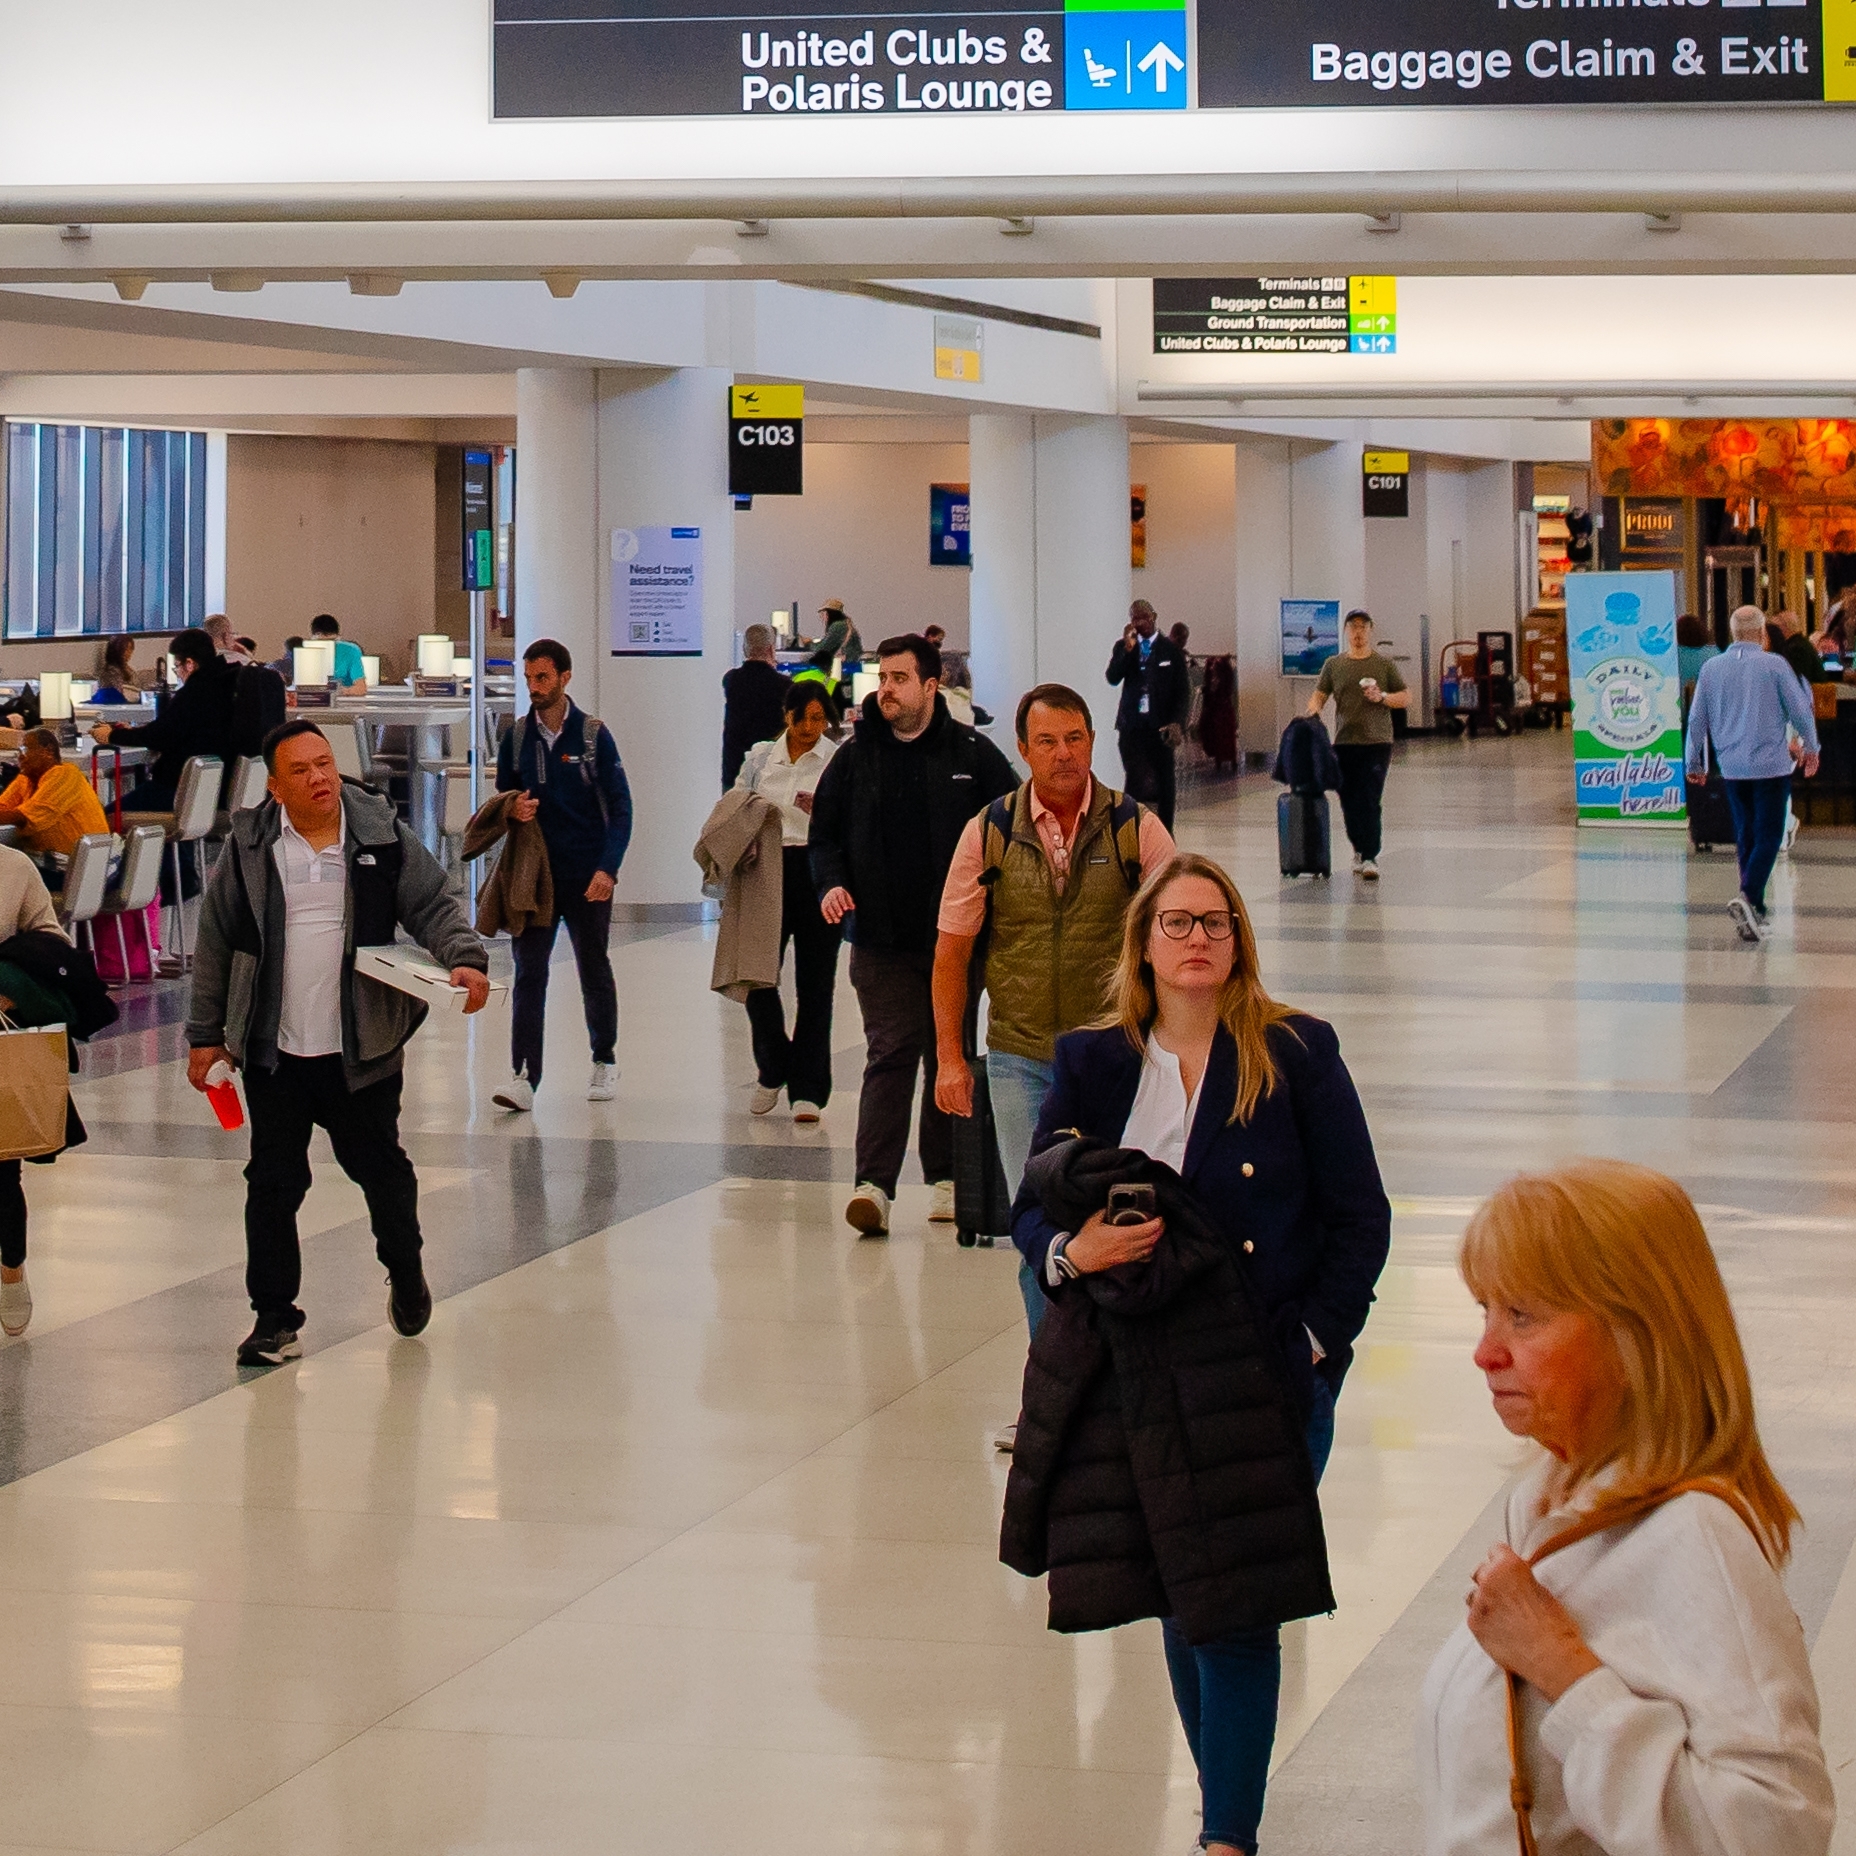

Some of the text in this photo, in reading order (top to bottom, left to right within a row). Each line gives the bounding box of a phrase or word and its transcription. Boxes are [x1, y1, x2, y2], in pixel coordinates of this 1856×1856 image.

[741, 27, 1052, 69] United Clubs &
[1311, 36, 1809, 91] Baggage Claim & Exit
[743, 74, 1052, 112] Polaris Lounge
[1258, 277, 1320, 291] Terminals
[1211, 296, 1346, 312] Baggage Claim & Exit
[1208, 315, 1346, 332] Ground Transportation
[1161, 336, 1346, 353] United Clubs & Polaris Lounge
[738, 425, 794, 446] C103
[1368, 475, 1401, 489] C101
[629, 564, 693, 575] Need travel
[629, 575, 695, 587] assistance?
[1595, 664, 1652, 684] DAILY
[1581, 753, 1673, 787] available
